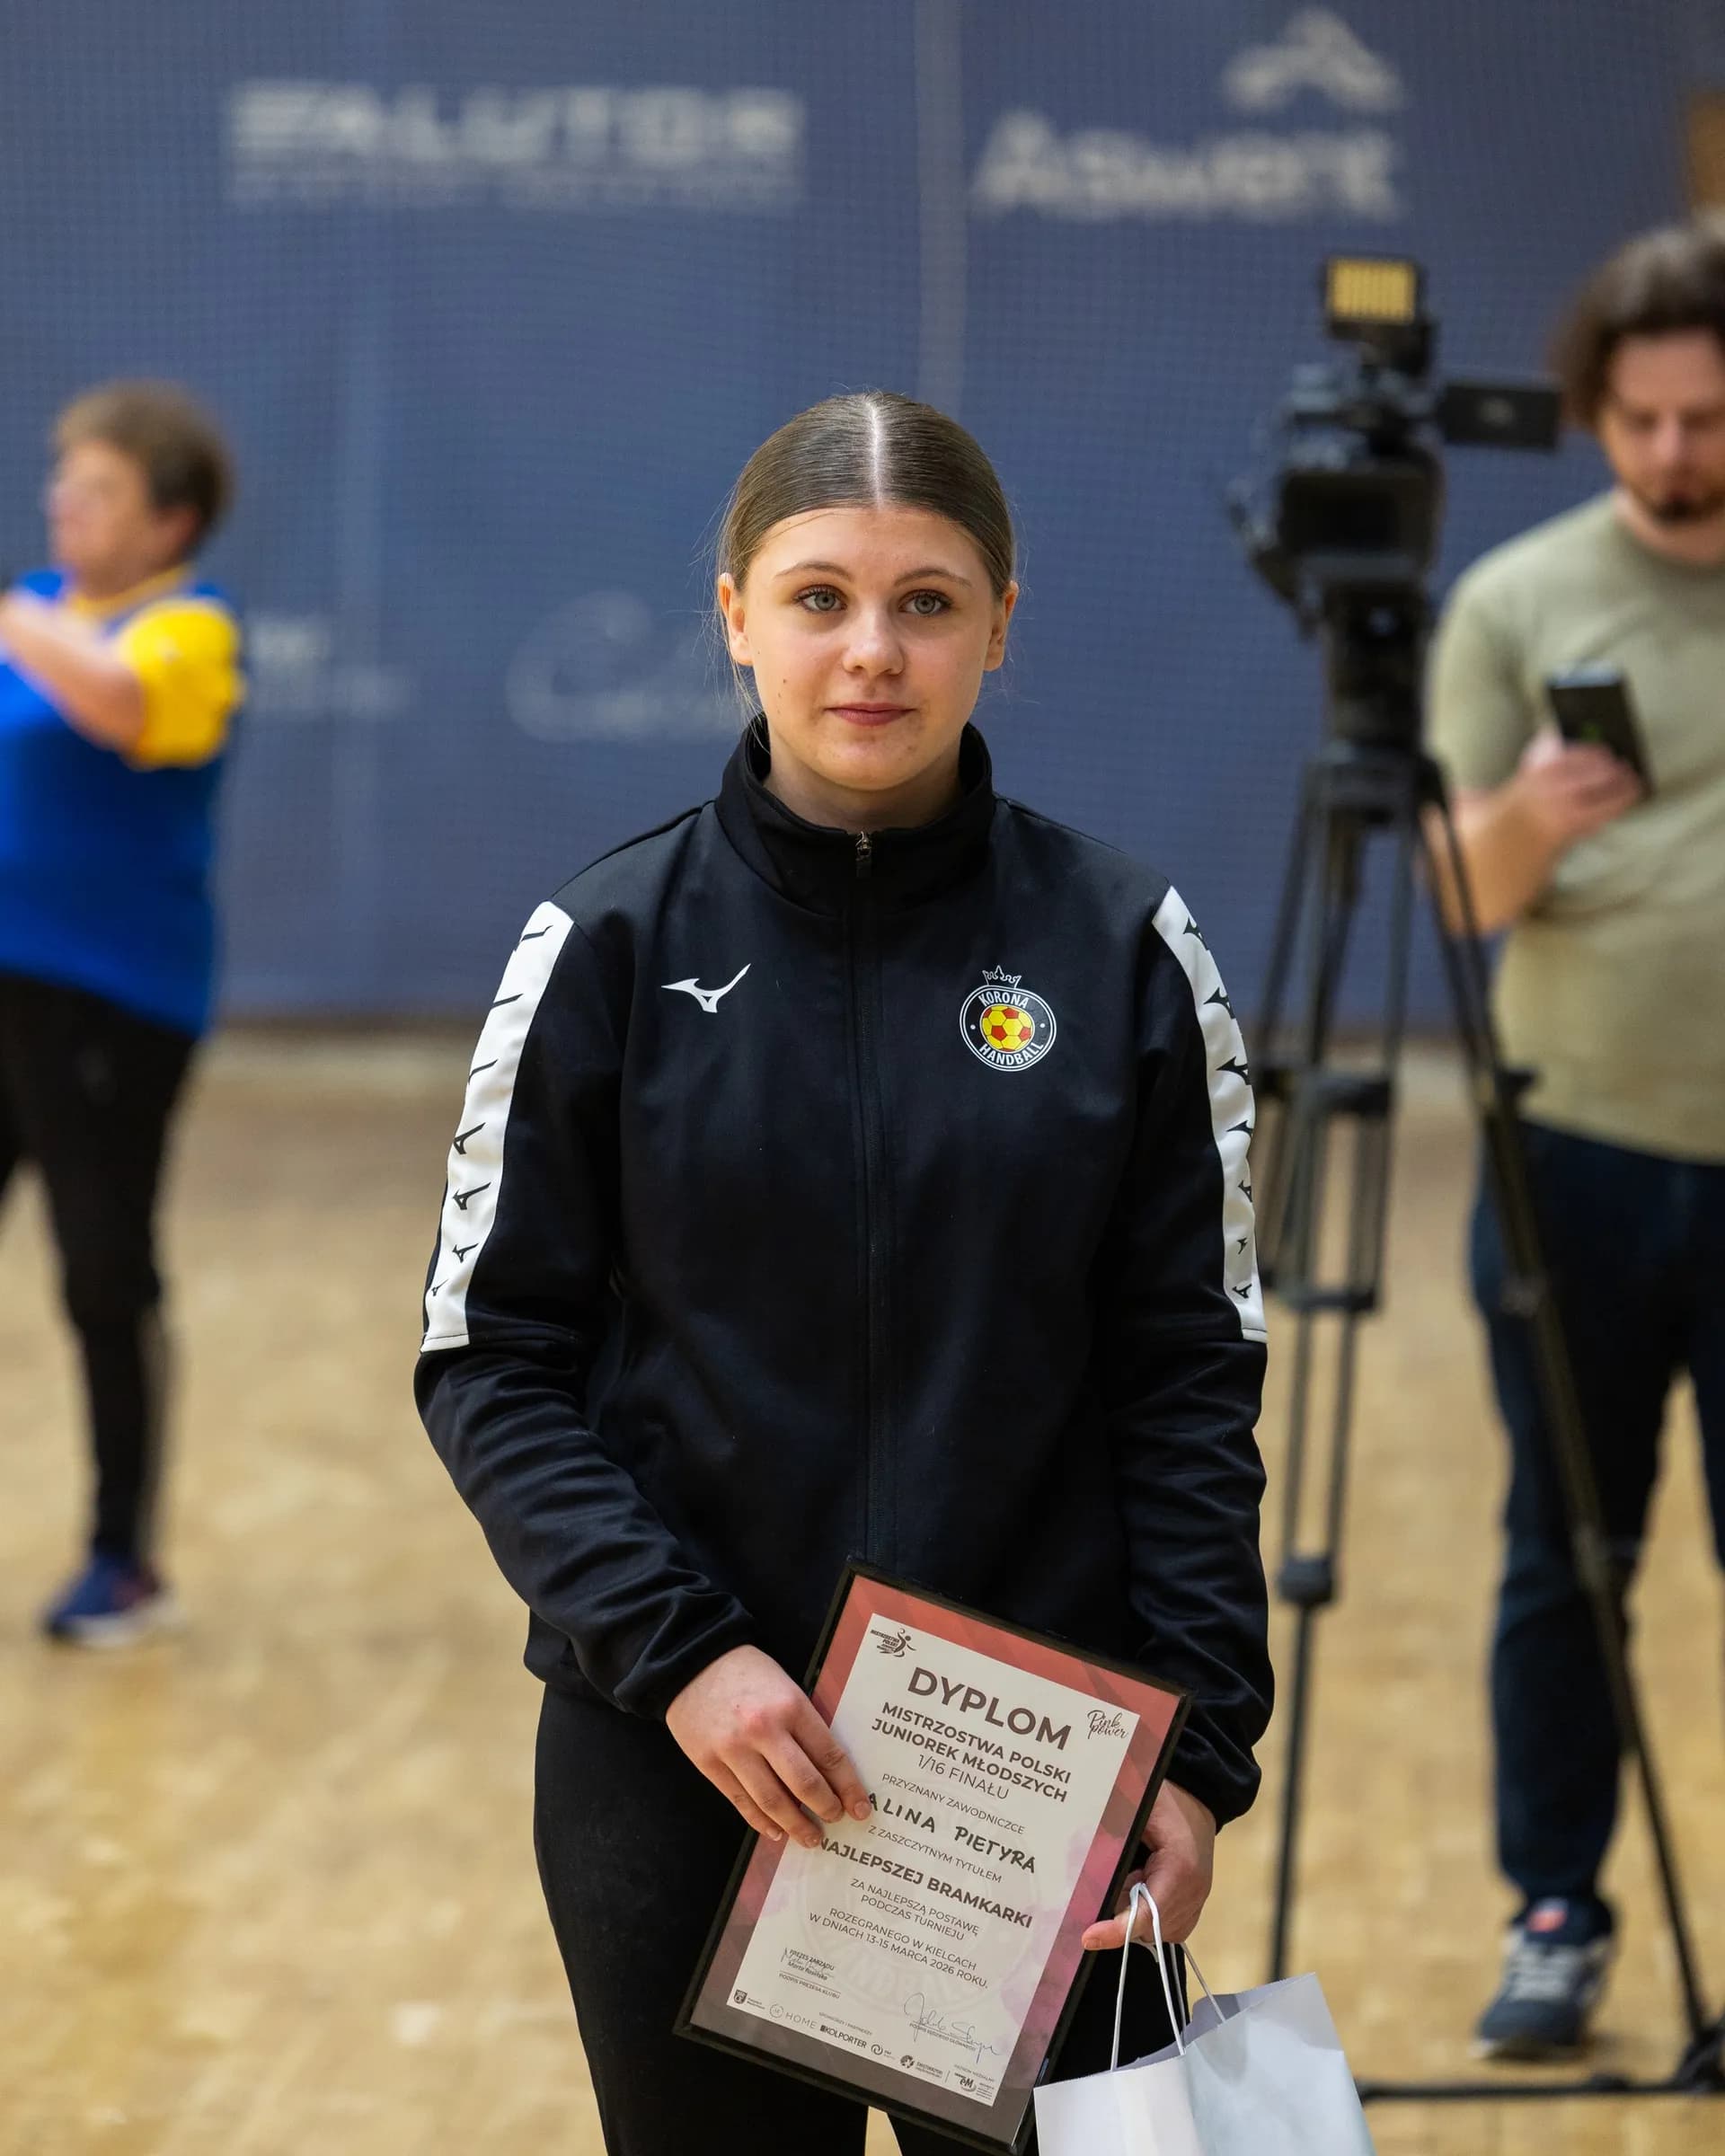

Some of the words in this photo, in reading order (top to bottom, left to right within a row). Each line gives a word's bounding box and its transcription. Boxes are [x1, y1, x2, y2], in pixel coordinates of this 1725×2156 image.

[978, 991, 1030, 1009] KORONA
[979, 1042, 1044, 1065] HANDBALL
[907, 1666, 1072, 1751] DYPLOM
[1087, 1710, 1122, 1728] Pink
[871, 1718, 960, 1761] JUNIOREK
[960, 1751, 1067, 1802] MŁODSZYCH
[881, 1701, 1004, 1759] MISTRZOSTWA
[1008, 1750, 1071, 1784] POLSKI
[880, 1772, 945, 1803] PRZYZNANY
[945, 1797, 1025, 1834] ZAWODNICZCE
[917, 1754, 946, 1775] 1/16
[948, 1766, 1009, 1799] FINAŁU
[867, 1824, 877, 1834] Z
[876, 1827, 953, 1863] ZASZCZYTNYM
[954, 1857, 1002, 1883] TYTUŁEM
[953, 1825, 1035, 1874] PIETYRA
[819, 1837, 924, 1885] NAJLEPSZEJ
[926, 1877, 1032, 1929] BRAMKARKI
[849, 1878, 864, 1890] ZA
[866, 1883, 925, 1915] NAJLEPSZĄ
[927, 1907, 979, 1937] POSTAWĘ
[828, 1906, 910, 1944] ROZEGRANEGO
[912, 1938, 924, 1949] W
[924, 1943, 977, 1971] KIELCACH
[860, 1894, 912, 1920] PODCZAS
[914, 1913, 965, 1940] TURNIEJU
[809, 1912, 821, 1922] W
[821, 1916, 864, 1940] DNIACH
[865, 1932, 889, 1949] 13-15
[889, 1942, 927, 1965] MARCA
[928, 1957, 955, 1975] 2026
[955, 1968, 987, 1989] ROKU.
[784, 2010, 818, 2029] HOME
[825, 2026, 867, 2048] KOLPORTER
